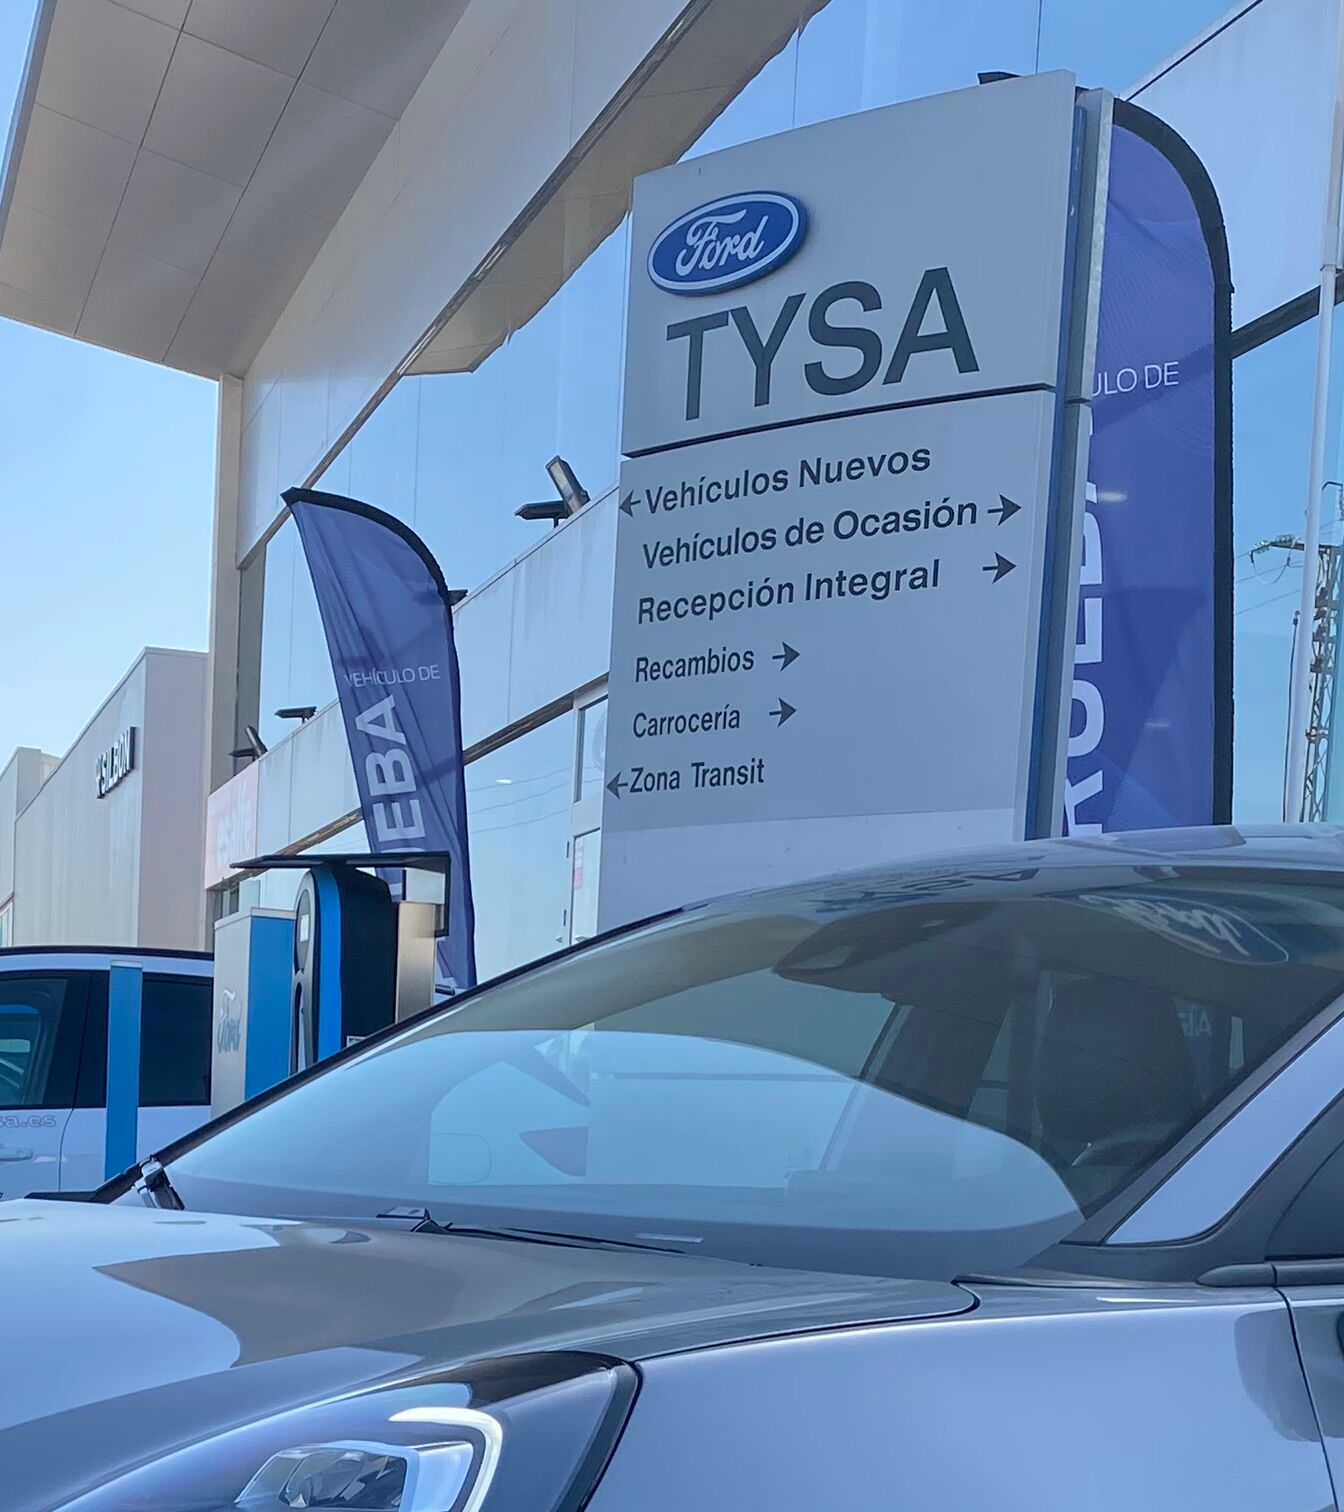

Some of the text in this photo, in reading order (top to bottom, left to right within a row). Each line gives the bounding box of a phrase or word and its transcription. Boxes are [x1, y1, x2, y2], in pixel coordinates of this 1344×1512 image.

[675, 208, 769, 276] Ford
[666, 266, 980, 422] TYSA
[1144, 361, 1179, 389] DE
[644, 448, 931, 515] Vehículos Nuevos
[642, 496, 978, 569] Vehículos de Ocasión
[638, 558, 940, 625] Recepción Integral
[344, 664, 441, 688] VEHÍCULO DE
[635, 646, 755, 683] Recambios
[632, 704, 741, 739] Carrocería
[629, 757, 765, 793] Zona Transit
